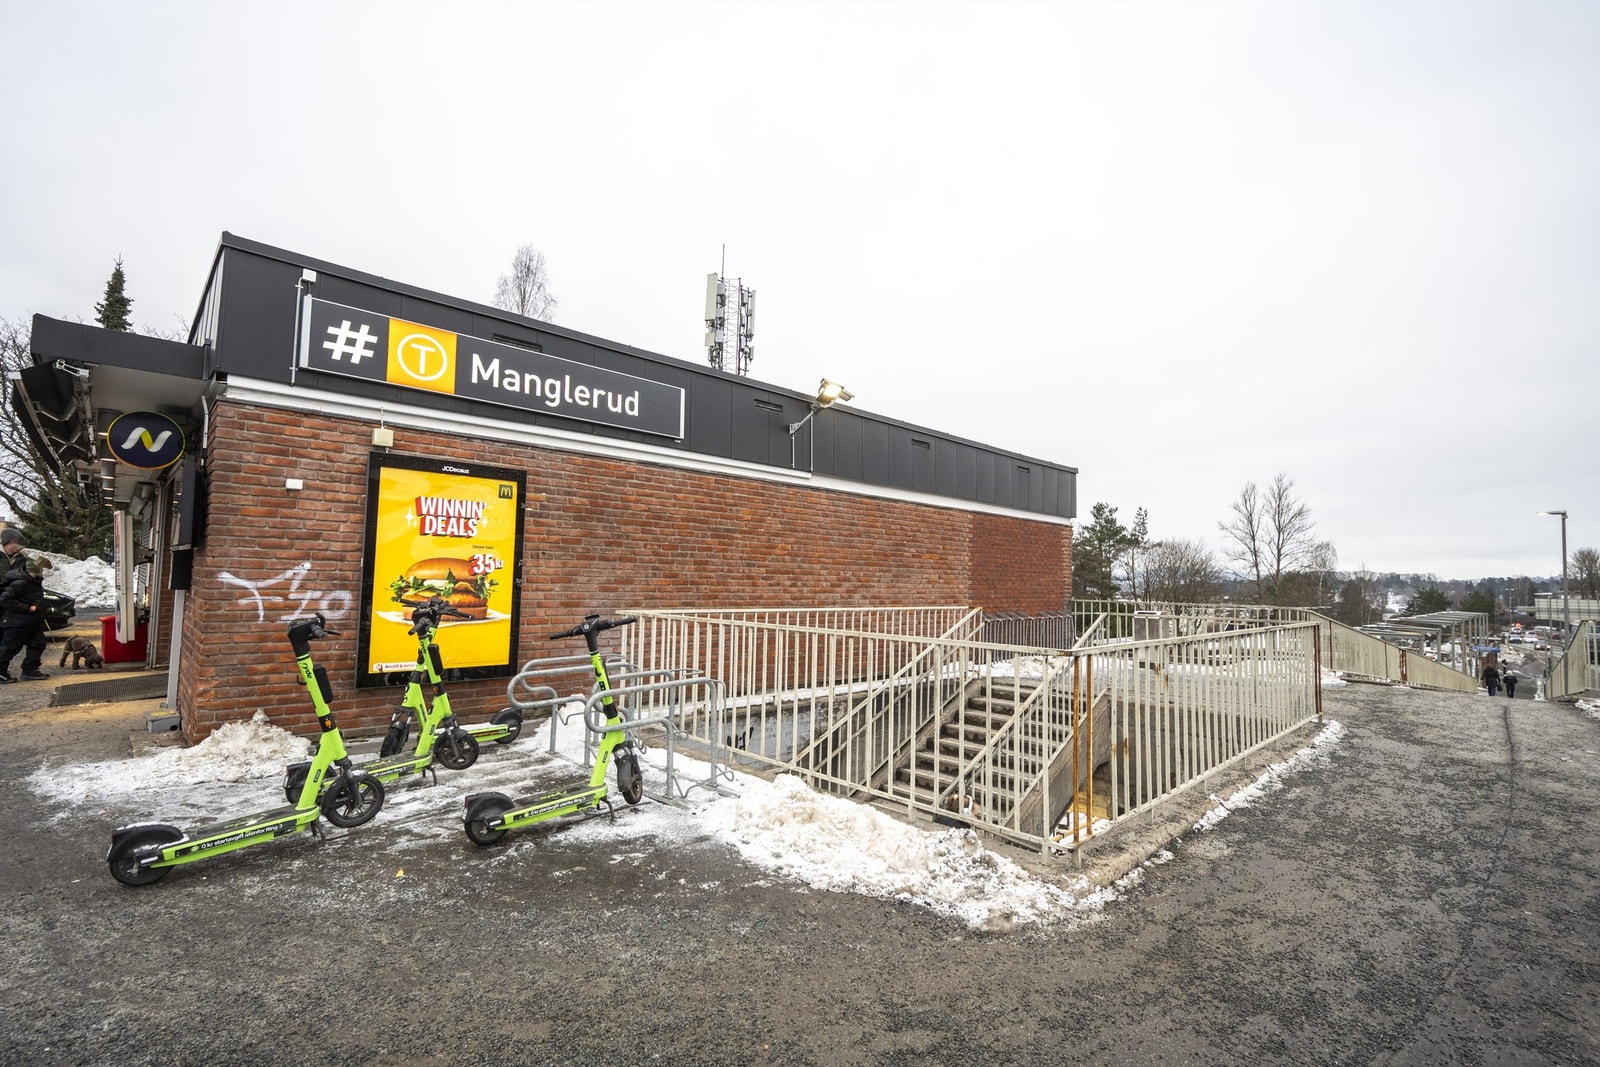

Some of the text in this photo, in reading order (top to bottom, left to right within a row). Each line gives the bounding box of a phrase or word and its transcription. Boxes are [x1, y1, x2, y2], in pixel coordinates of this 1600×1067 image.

[471, 353, 639, 417] Manglerud
[442, 465, 470, 474] JCDecaux
[423, 515, 479, 538] DEALS
[214, 833, 245, 845] startavgift
[245, 828, 266, 837] utenfor
[266, 824, 278, 832] Ring
